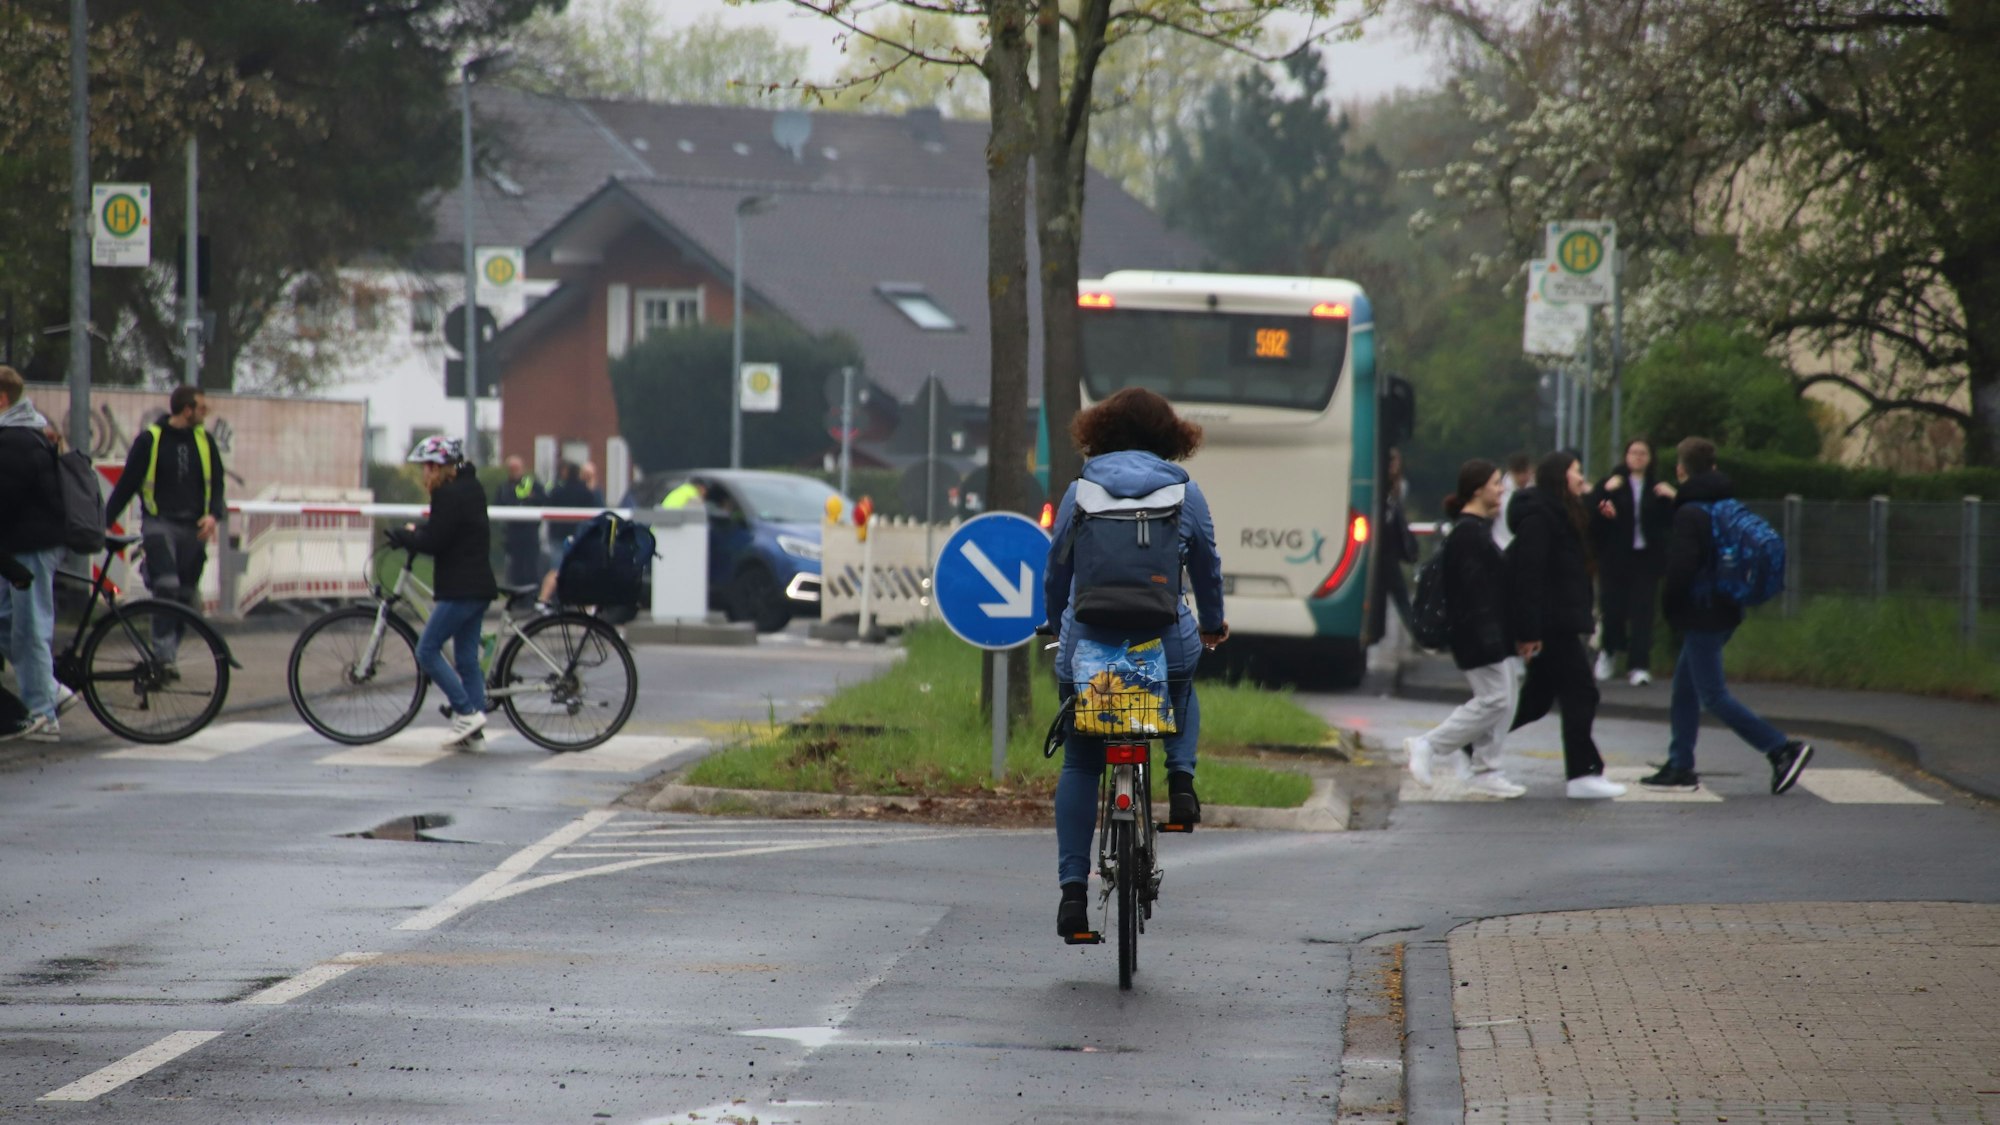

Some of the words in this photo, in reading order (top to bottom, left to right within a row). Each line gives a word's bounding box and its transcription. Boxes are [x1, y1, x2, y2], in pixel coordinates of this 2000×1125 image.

[113, 202, 130, 230] H
[1572, 239, 1591, 267] H
[1256, 328, 1288, 357] 592
[1241, 527, 1303, 550] RSVG
